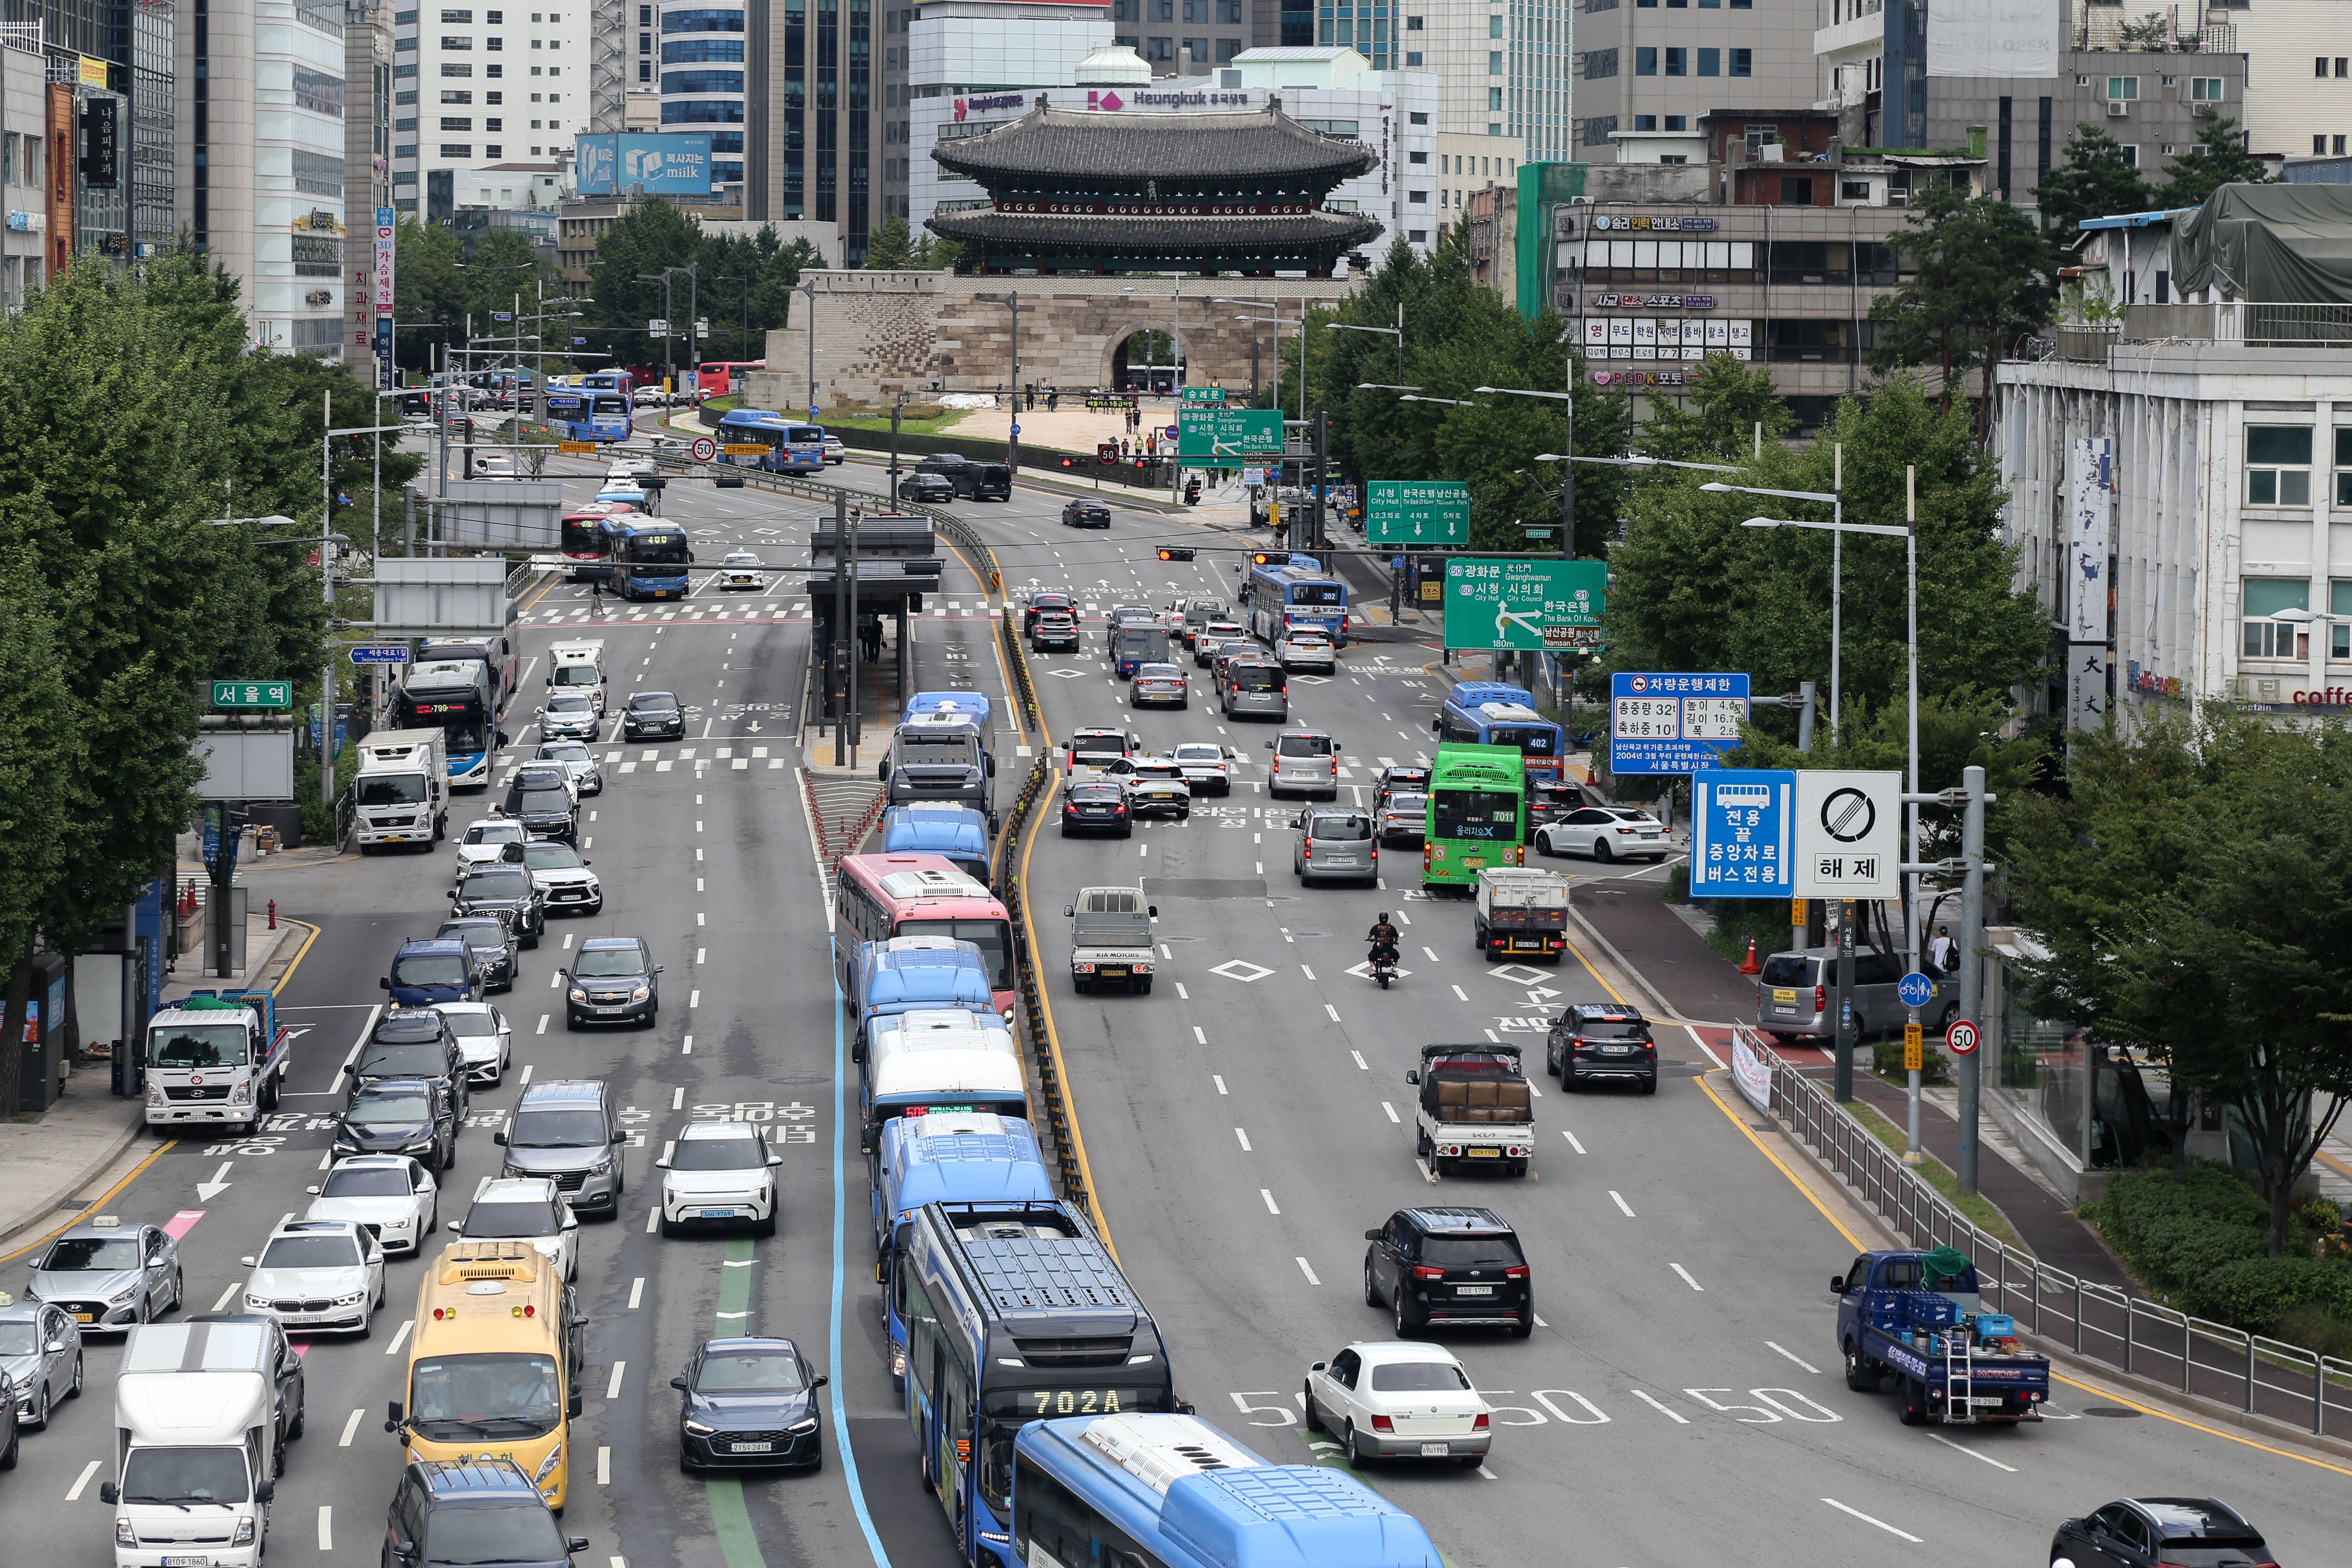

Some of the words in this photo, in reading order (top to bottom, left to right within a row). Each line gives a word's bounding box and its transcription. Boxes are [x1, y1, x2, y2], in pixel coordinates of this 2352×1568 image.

[1134, 91, 1206, 107] Heungkuk
[101, 107, 113, 175] 나음피부과
[598, 148, 613, 162] 복사지는
[667, 153, 704, 164] 복사지는
[598, 164, 611, 181] miilk
[667, 165, 699, 178] miilk
[1147, 180, 1157, 200] 崇禮門
[380, 216, 390, 225] 암
[1611, 217, 1630, 230] 승리
[1631, 217, 1650, 230] 인력
[1651, 217, 1680, 230] 안내소
[379, 241, 391, 249] 3D
[379, 251, 390, 303] 가슴제작
[1596, 294, 1619, 306] 사교
[1621, 295, 1643, 307] 댄스
[1646, 294, 1681, 307] 스포츠
[355, 272, 367, 344] 치과재료
[1591, 325, 1602, 337] 영
[1612, 326, 1629, 337] 무도
[1636, 326, 1654, 337] 학원
[1660, 326, 1678, 337] 자이브
[1684, 326, 1701, 337] 룸바
[1708, 327, 1725, 338] 왈츠
[1732, 327, 1749, 338] 탱고
[1614, 373, 1656, 384] REDK
[1659, 373, 1682, 385] 포토
[1188, 389, 1219, 400] 숭례문
[1191, 413, 1215, 421] 광화문
[1220, 424, 1242, 432] 시의회
[1243, 435, 1272, 443] 한국은행
[697, 444, 711, 454] 50
[1102, 450, 1114, 459] 50
[1377, 489, 1394, 497] 시청
[1403, 489, 1435, 498] 한국은행
[1436, 489, 1467, 498] 남산공원
[648, 536, 667, 544] 400
[1465, 565, 1501, 578] 광화문
[1506, 564, 1531, 573] 光化門
[1505, 573, 1551, 582] Gwanghwamun
[1426, 588, 1441, 597] 댄스
[1476, 582, 1499, 594] 시청
[1508, 583, 1543, 595] 시의회
[1544, 600, 1589, 613] 한국은행
[1544, 614, 1556, 622] The
[1557, 614, 1572, 622] Bank
[1545, 628, 1575, 637] 남산공원
[1492, 640, 1514, 648] 180m
[1650, 677, 1730, 692] 차량운행제한
[220, 686, 284, 703] 서울역
[1619, 702, 1651, 715] 총중량
[1656, 704, 1676, 716] 32t
[1687, 700, 1708, 711] 높이
[2236, 704, 2272, 712] captain
[1686, 714, 1707, 724] 길이
[1618, 722, 1651, 735] 축하중
[1656, 724, 1675, 735] 10t
[1693, 726, 1702, 737] 폭
[1531, 738, 1546, 748] 402
[1650, 761, 1709, 770] 서울특별시장
[1494, 812, 1514, 822] 7011
[1725, 810, 1761, 827] 전용
[1456, 825, 1494, 836] 올리지오X
[1735, 827, 1752, 842] 끝
[1709, 843, 1776, 862] 중앙차로
[1819, 858, 1875, 878] 해제
[1709, 865, 1776, 883] 버스전용
[1908, 1034, 1912, 1044] 불법
[1953, 1030, 1973, 1046] 50
[692, 1101, 816, 1122] 후암동
[1977, 1370, 2021, 1379] MOTORS
[1034, 1390, 1120, 1413] 702A
[1682, 1388, 1844, 1423] 50
[1487, 1390, 1611, 1426] 50
